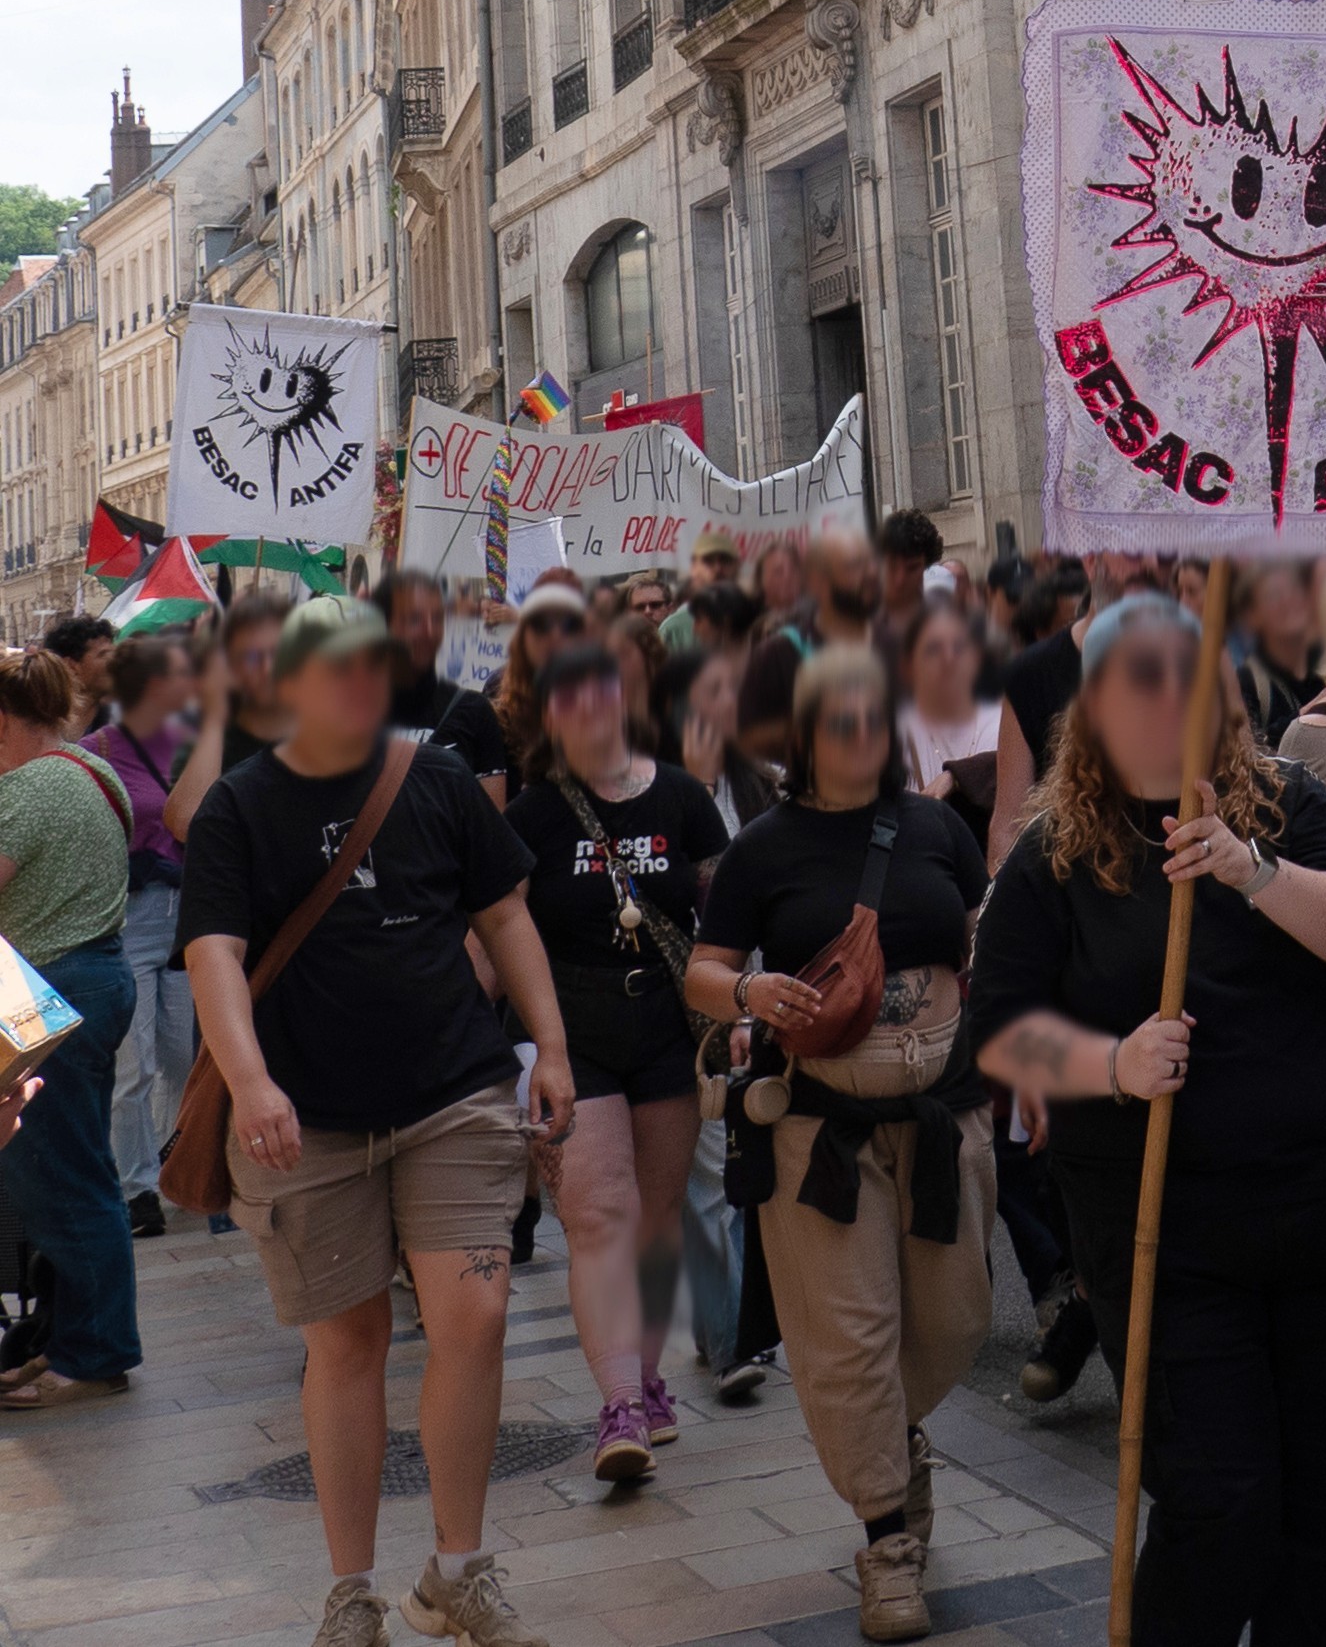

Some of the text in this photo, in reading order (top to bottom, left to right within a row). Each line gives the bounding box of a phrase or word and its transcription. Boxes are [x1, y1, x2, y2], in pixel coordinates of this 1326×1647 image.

[1054, 319, 1234, 506] BESAC
[193, 426, 365, 507] BESAC ANTIFA
[621, 515, 688, 555] POLICE
